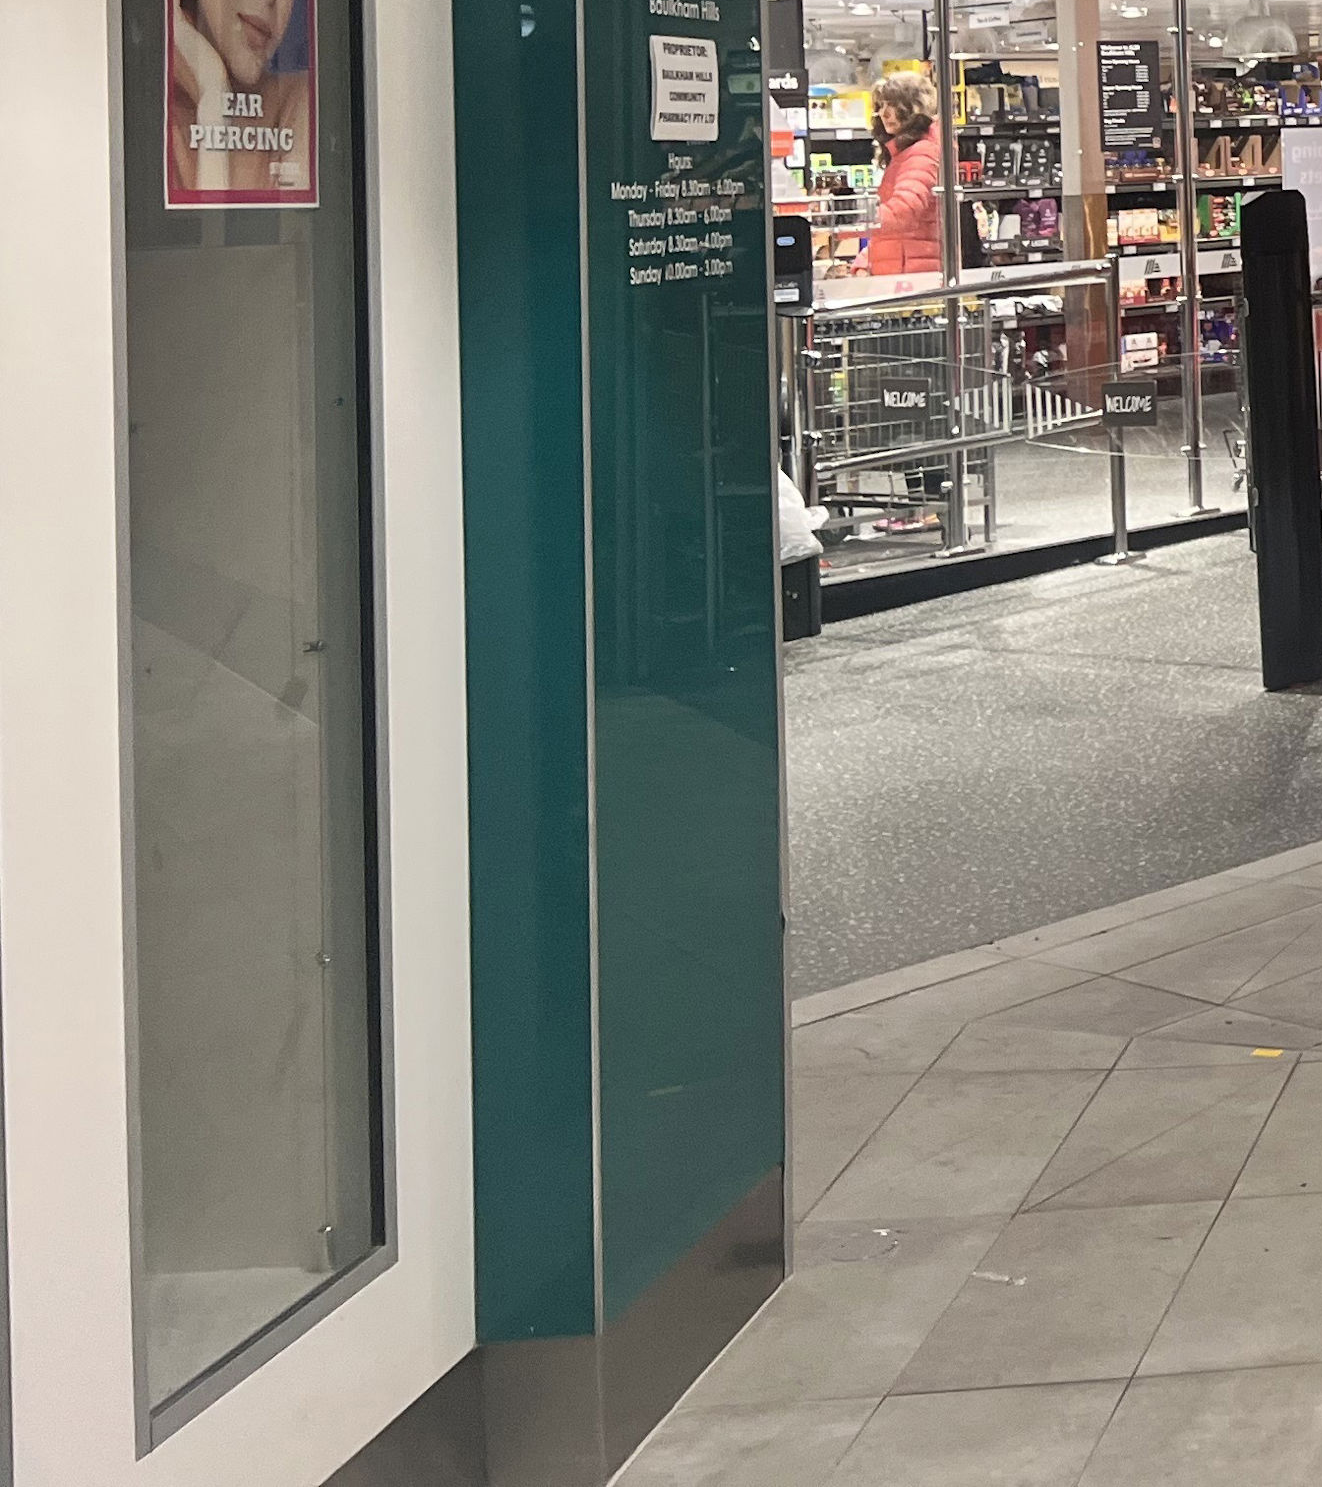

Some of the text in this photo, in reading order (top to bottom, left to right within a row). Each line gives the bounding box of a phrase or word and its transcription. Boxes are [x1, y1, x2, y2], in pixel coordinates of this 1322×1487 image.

[701, 0, 720, 22] Hills
[768, 72, 799, 90] ards
[222, 92, 264, 118] EAR
[693, 113, 704, 124] PTY
[189, 124, 294, 152] PIERCING
[611, 180, 648, 202] Monday
[655, 180, 681, 201] Friday
[681, 179, 711, 198] 8.30am
[716, 178, 745, 199] 6.00pm
[628, 209, 666, 230] Thursday
[667, 207, 698, 225] 8.30am
[703, 205, 732, 225] 6.00pm
[628, 237, 667, 258] Saturday
[668, 234, 698, 253] 8.30am
[704, 231, 733, 252] 4.00pm
[630, 265, 662, 286] Sunday
[665, 261, 698, 281] 10.00am
[704, 258, 733, 278] 3.00pm
[883, 388, 927, 409] WELCOME
[1105, 393, 1152, 413] WELCOME
